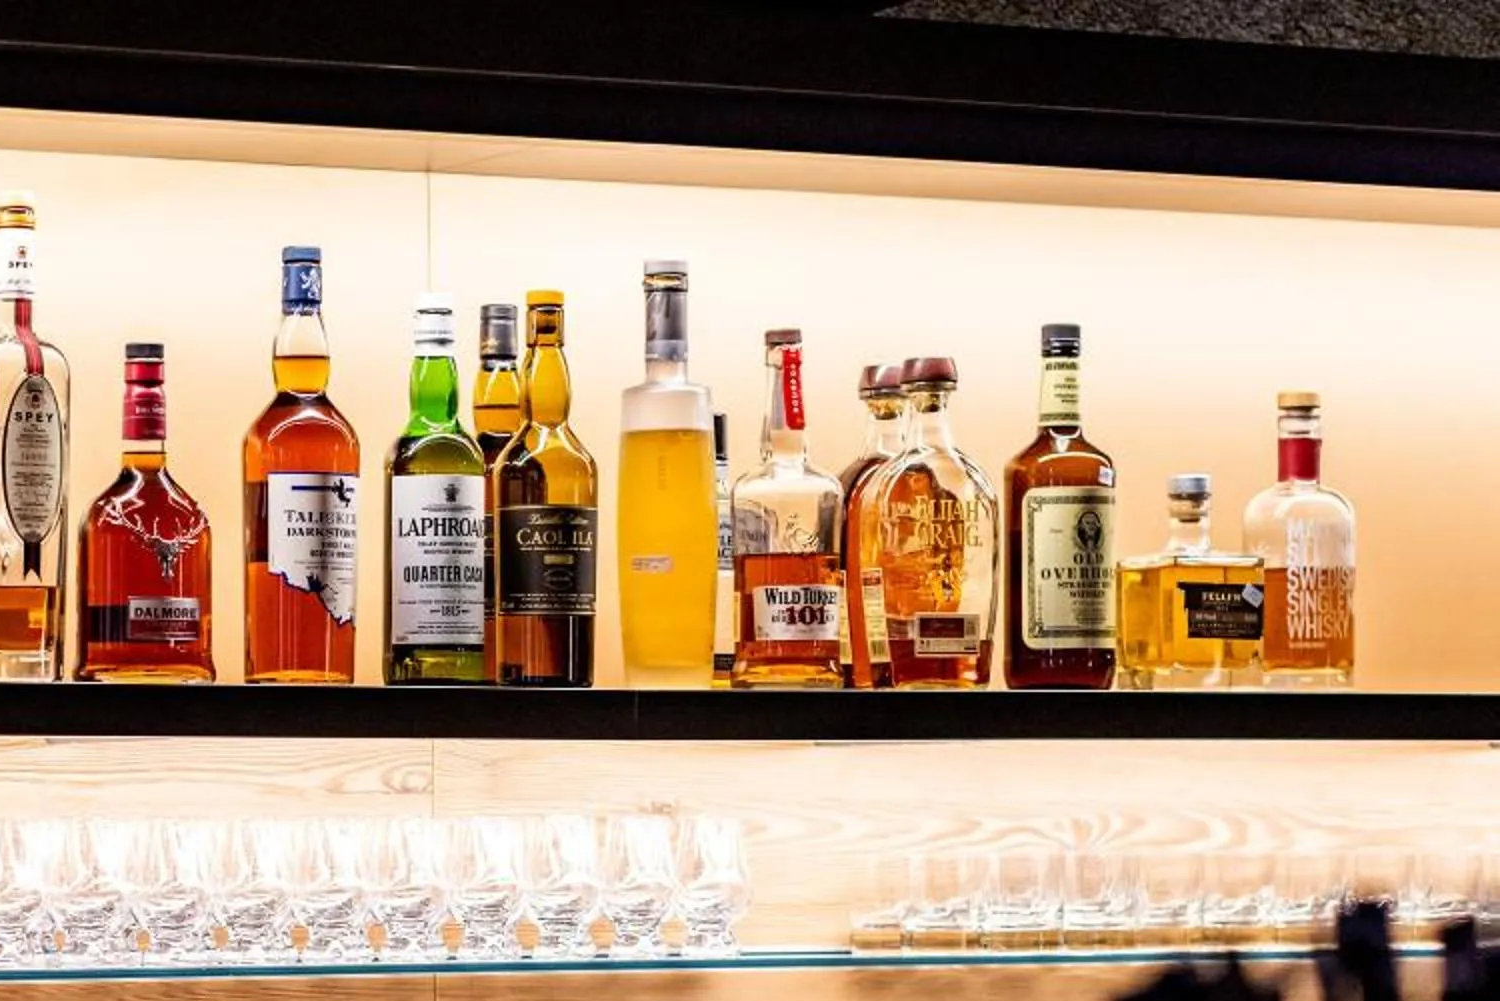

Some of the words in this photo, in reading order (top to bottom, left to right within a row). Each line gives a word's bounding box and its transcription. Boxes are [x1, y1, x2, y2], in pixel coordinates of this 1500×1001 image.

[14, 411, 55, 423] SPEY
[915, 496, 979, 522] ELIJAH
[516, 528, 566, 545] CAOL
[1073, 552, 1105, 565] OLD
[403, 565, 461, 583] QUARTER
[765, 588, 800, 605] WILD
[134, 607, 197, 618] DALMORE
[441, 605, 461, 617] 1815
[786, 606, 827, 625] 101
[1287, 612, 1350, 640] WHISKY
